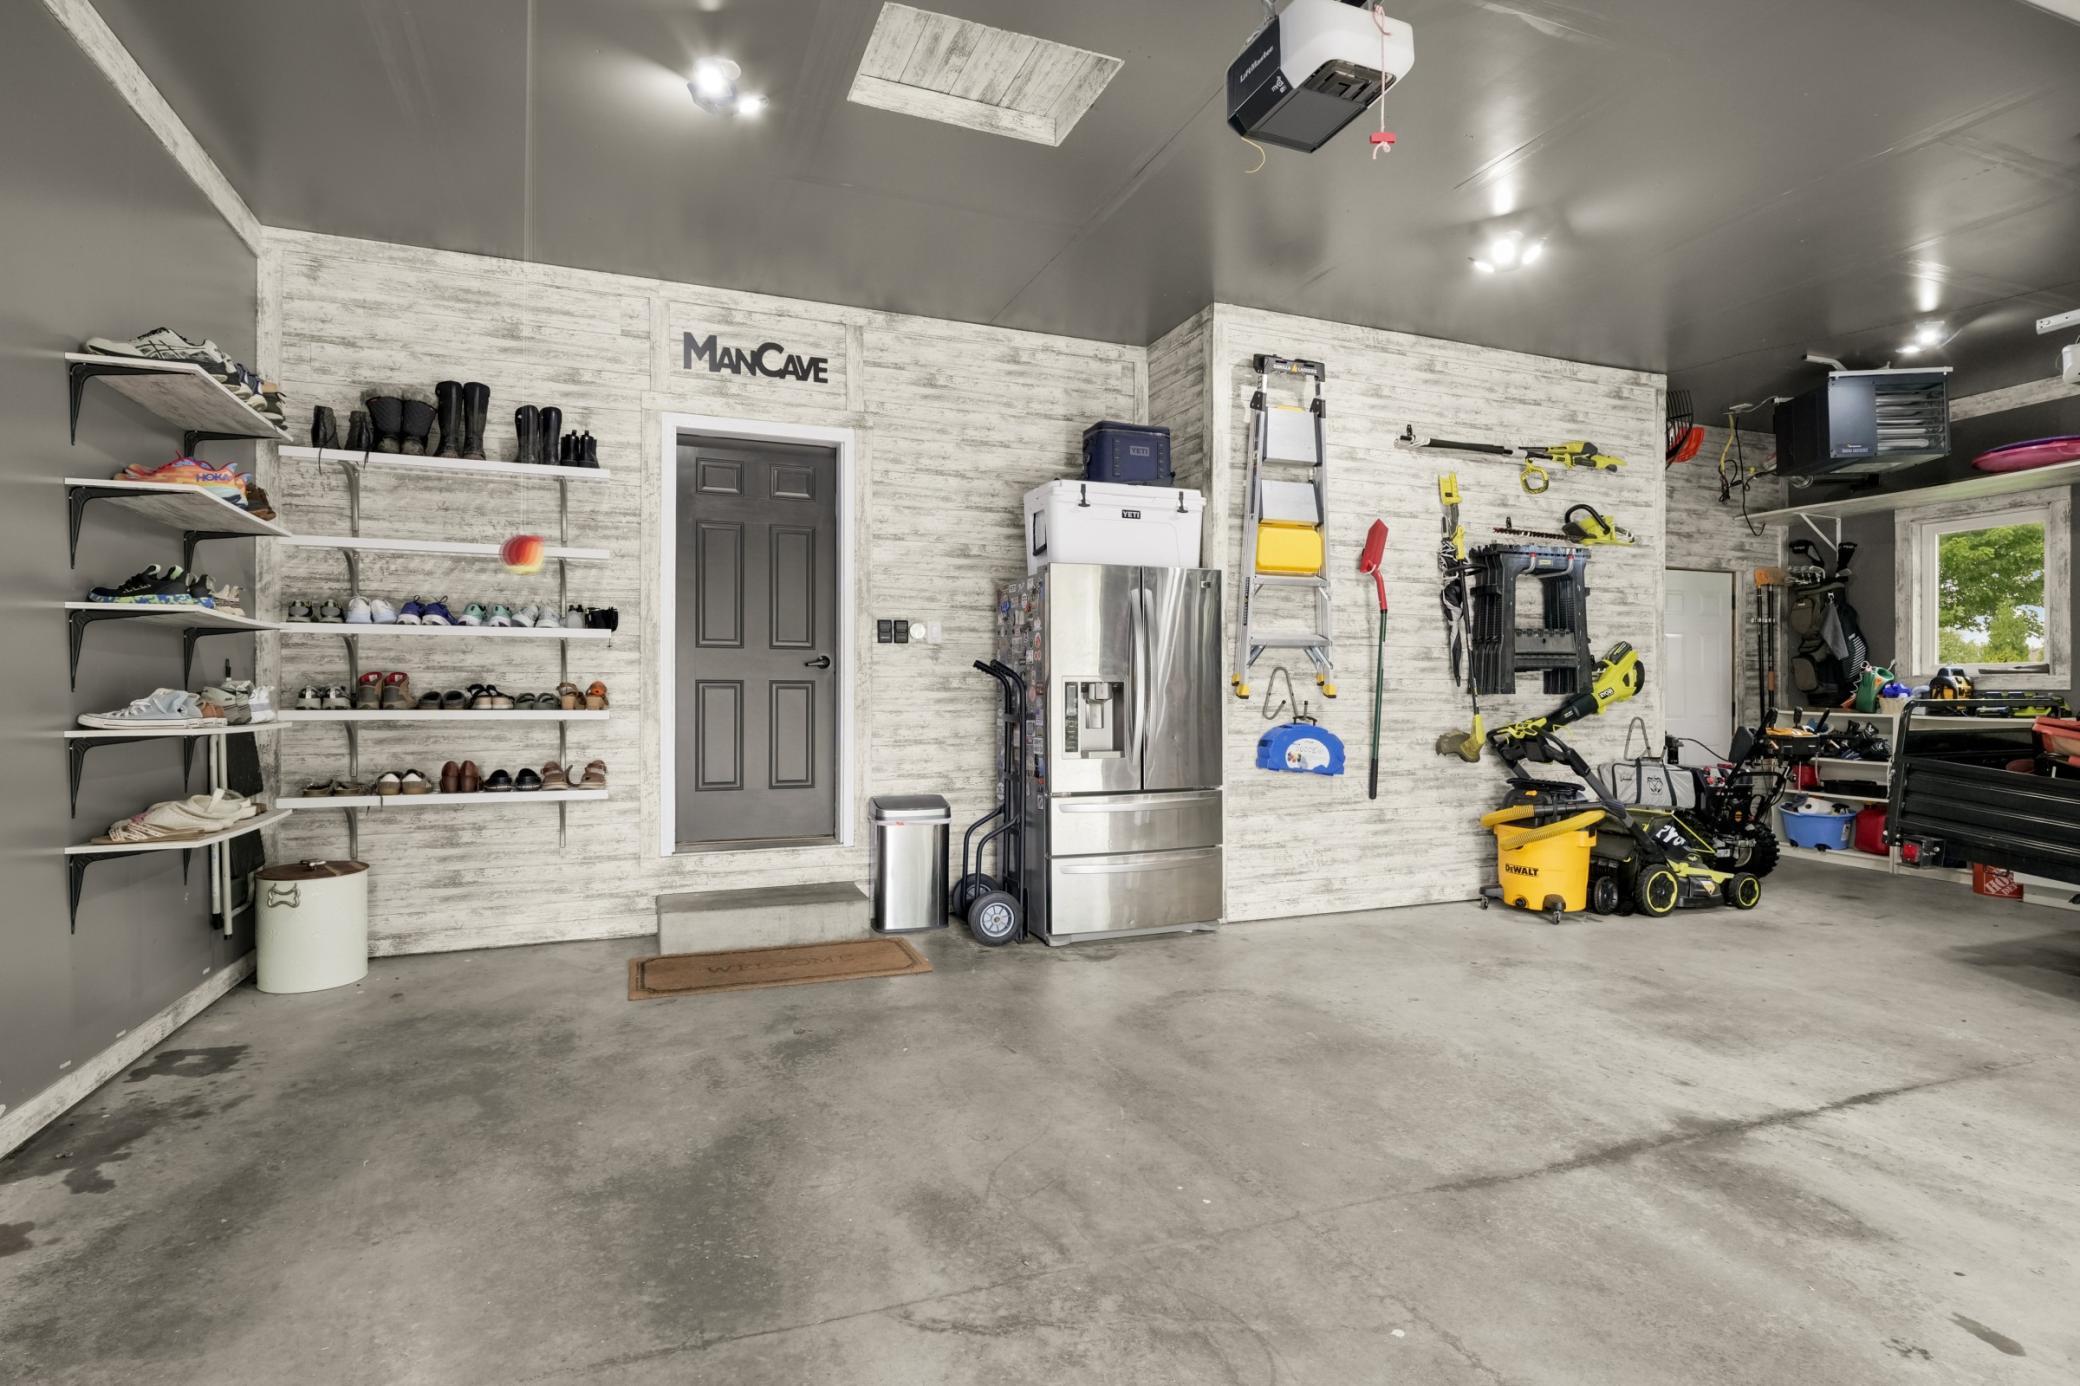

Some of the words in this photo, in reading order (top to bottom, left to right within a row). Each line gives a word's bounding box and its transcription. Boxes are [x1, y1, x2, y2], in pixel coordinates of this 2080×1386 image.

[1130, 446, 1149, 456] YETI
[1122, 510, 1140, 519] YETI
[708, 953, 855, 974] WELCOME
